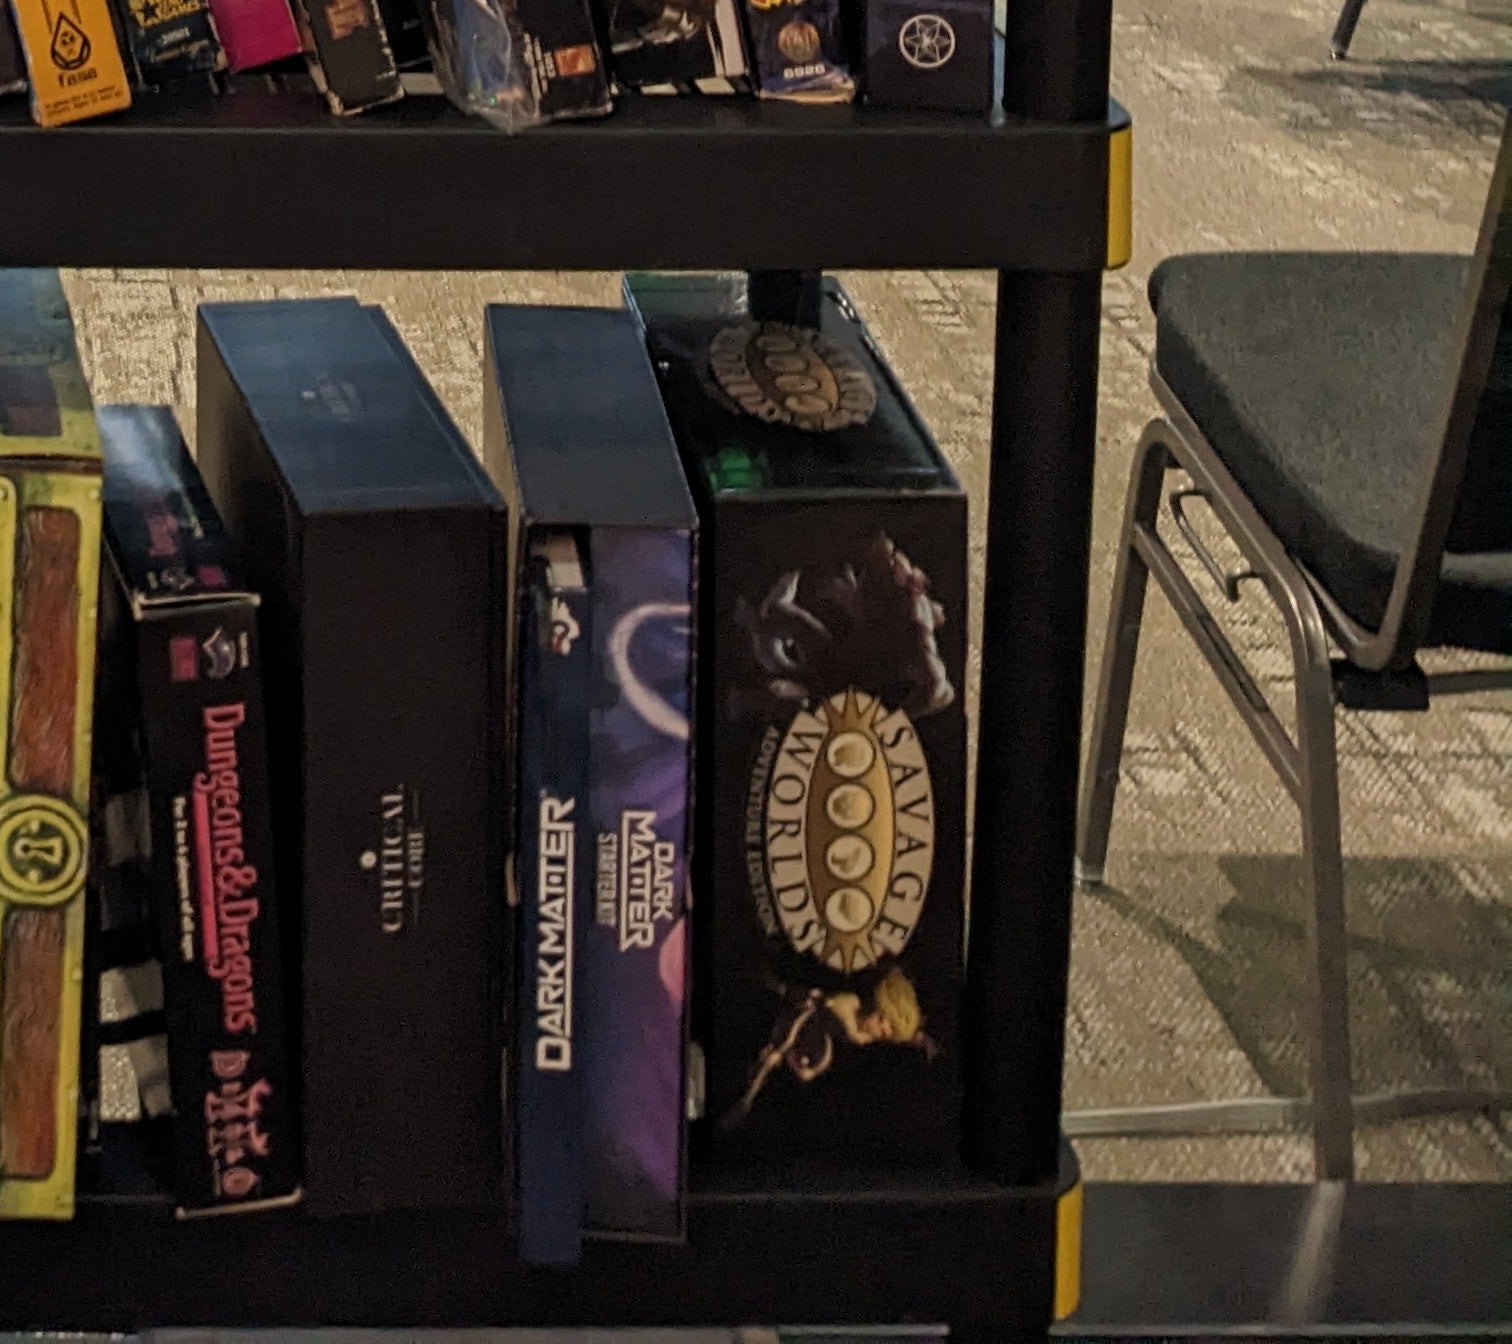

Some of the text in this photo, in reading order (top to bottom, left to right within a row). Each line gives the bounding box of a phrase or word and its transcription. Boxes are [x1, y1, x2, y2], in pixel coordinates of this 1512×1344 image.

[187, 702, 255, 867] Dungeons
[769, 729, 824, 941] WORLDS
[875, 726, 931, 940] SAVAGE
[214, 863, 258, 898] &
[380, 782, 406, 934] CRITICAL
[595, 832, 618, 926] STARTER KIT
[618, 810, 656, 951] MATTER
[652, 841, 675, 918] DARK
[202, 897, 267, 1034] Dragons
[534, 795, 576, 1071] DARK MATTER
